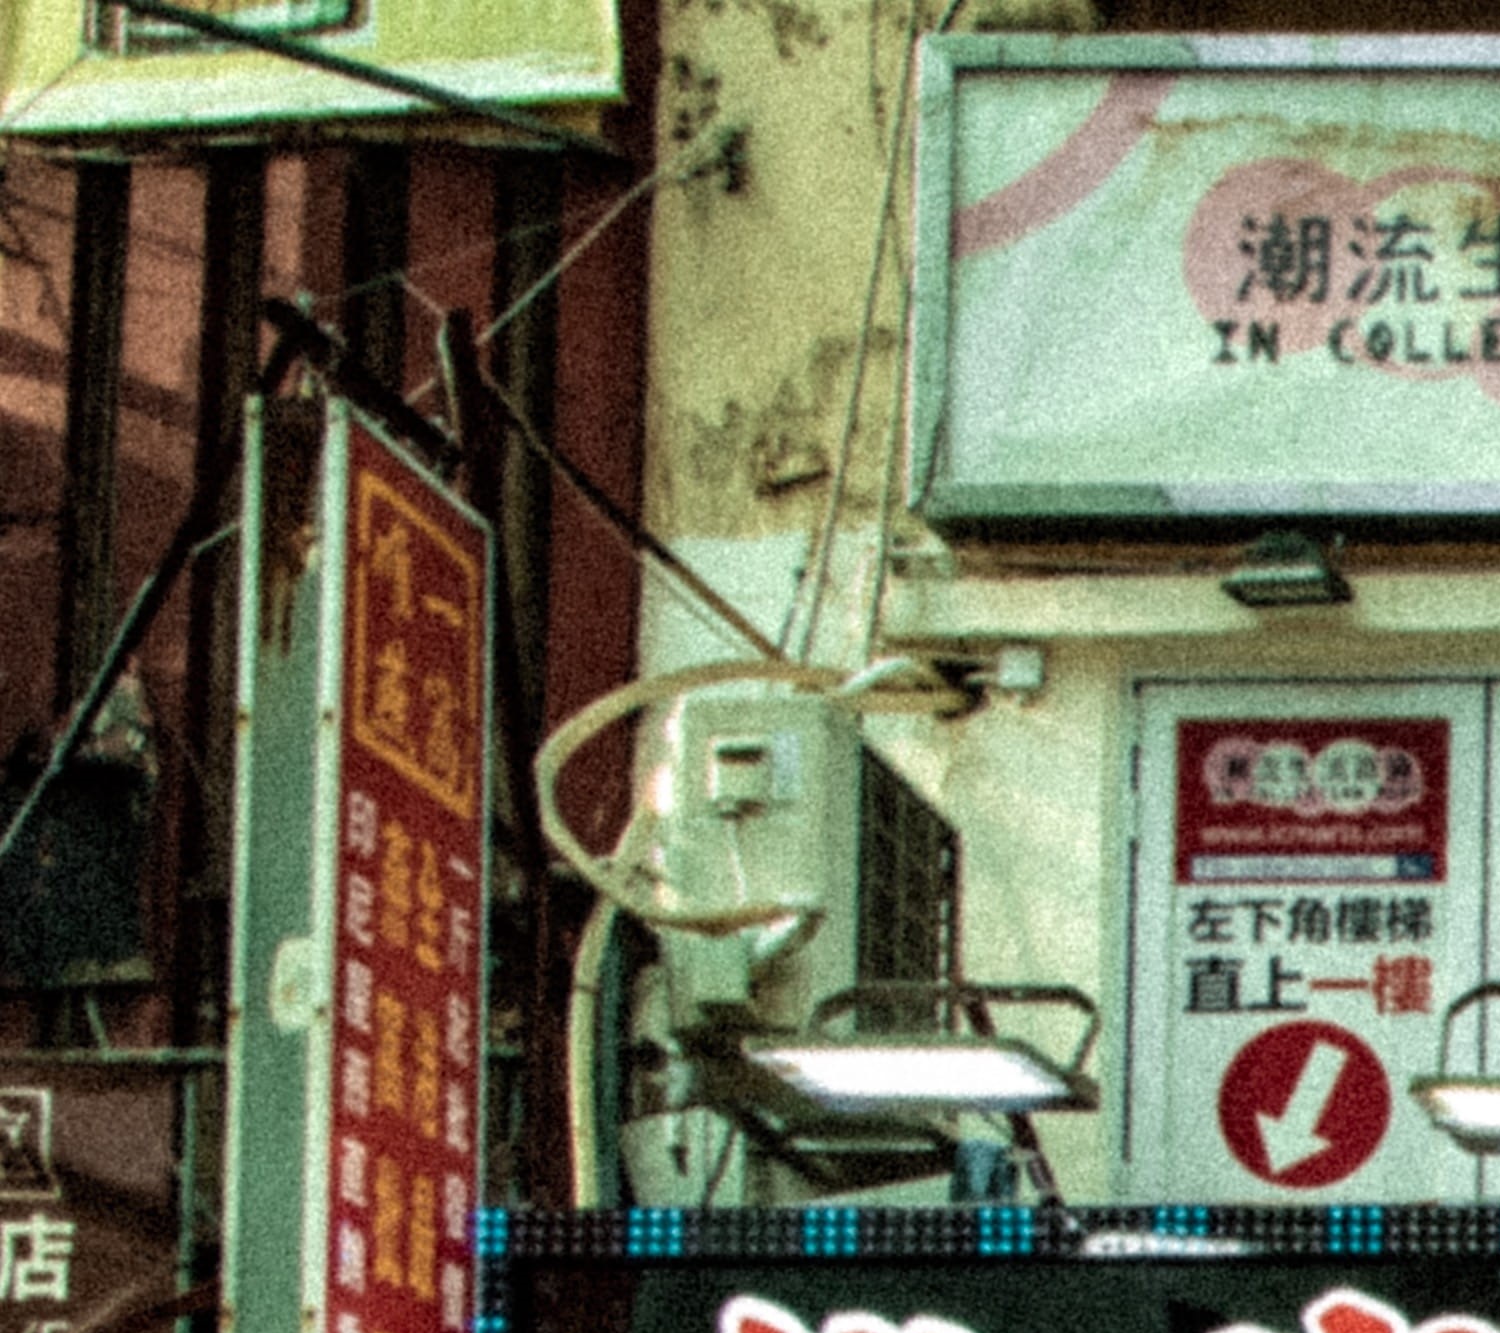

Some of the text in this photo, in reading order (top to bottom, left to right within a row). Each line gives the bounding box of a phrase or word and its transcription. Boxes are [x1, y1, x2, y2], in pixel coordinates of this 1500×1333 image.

[1212, 322, 1281, 366] IN
[1187, 895, 1432, 942] 左下角樓梯
[1184, 953, 1434, 1016] 直上一樓
[0, 1214, 76, 1302] 店
